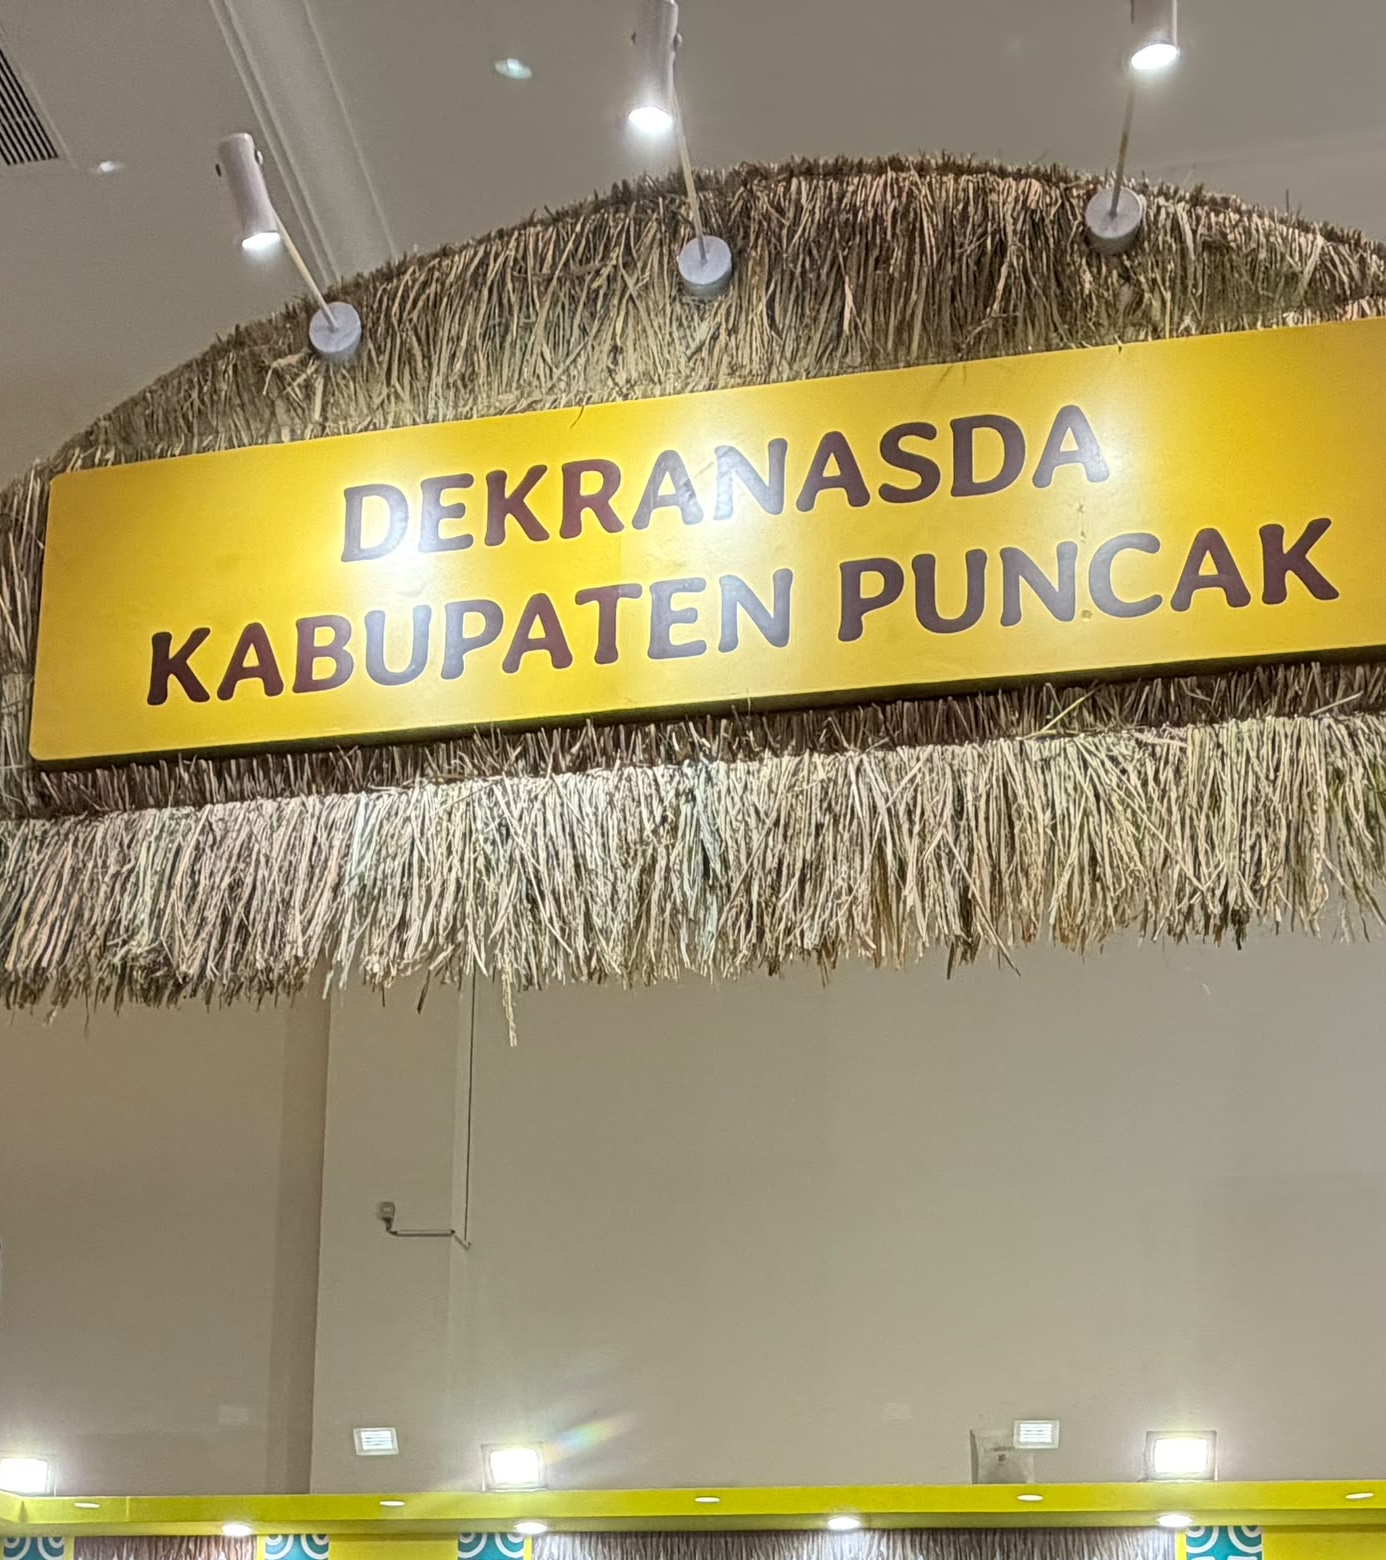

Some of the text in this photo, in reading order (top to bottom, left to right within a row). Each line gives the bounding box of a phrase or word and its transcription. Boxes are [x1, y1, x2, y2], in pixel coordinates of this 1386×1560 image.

[340, 403, 1111, 565] DEKRANASDA
[144, 517, 1341, 707] KABUPATEN PUNCAK
